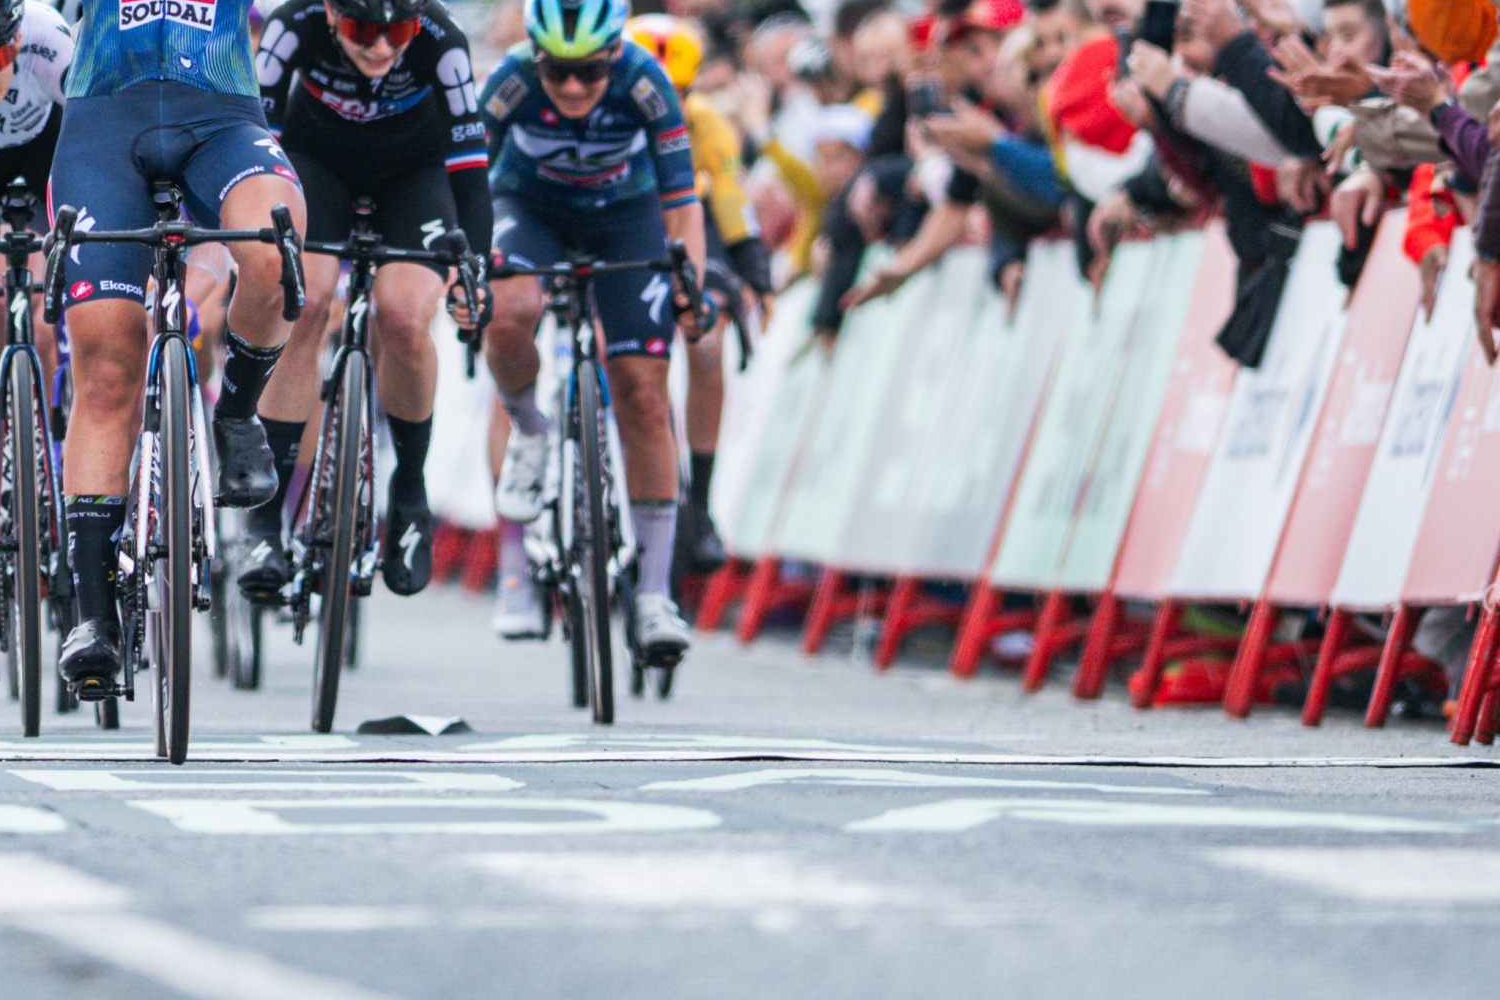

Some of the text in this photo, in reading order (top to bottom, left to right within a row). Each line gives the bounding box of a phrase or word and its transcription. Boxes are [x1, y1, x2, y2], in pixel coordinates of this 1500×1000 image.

[121, 0, 212, 26] SOUDAL
[219, 165, 266, 201] Ekopak
[99, 280, 144, 297] Ekopak
